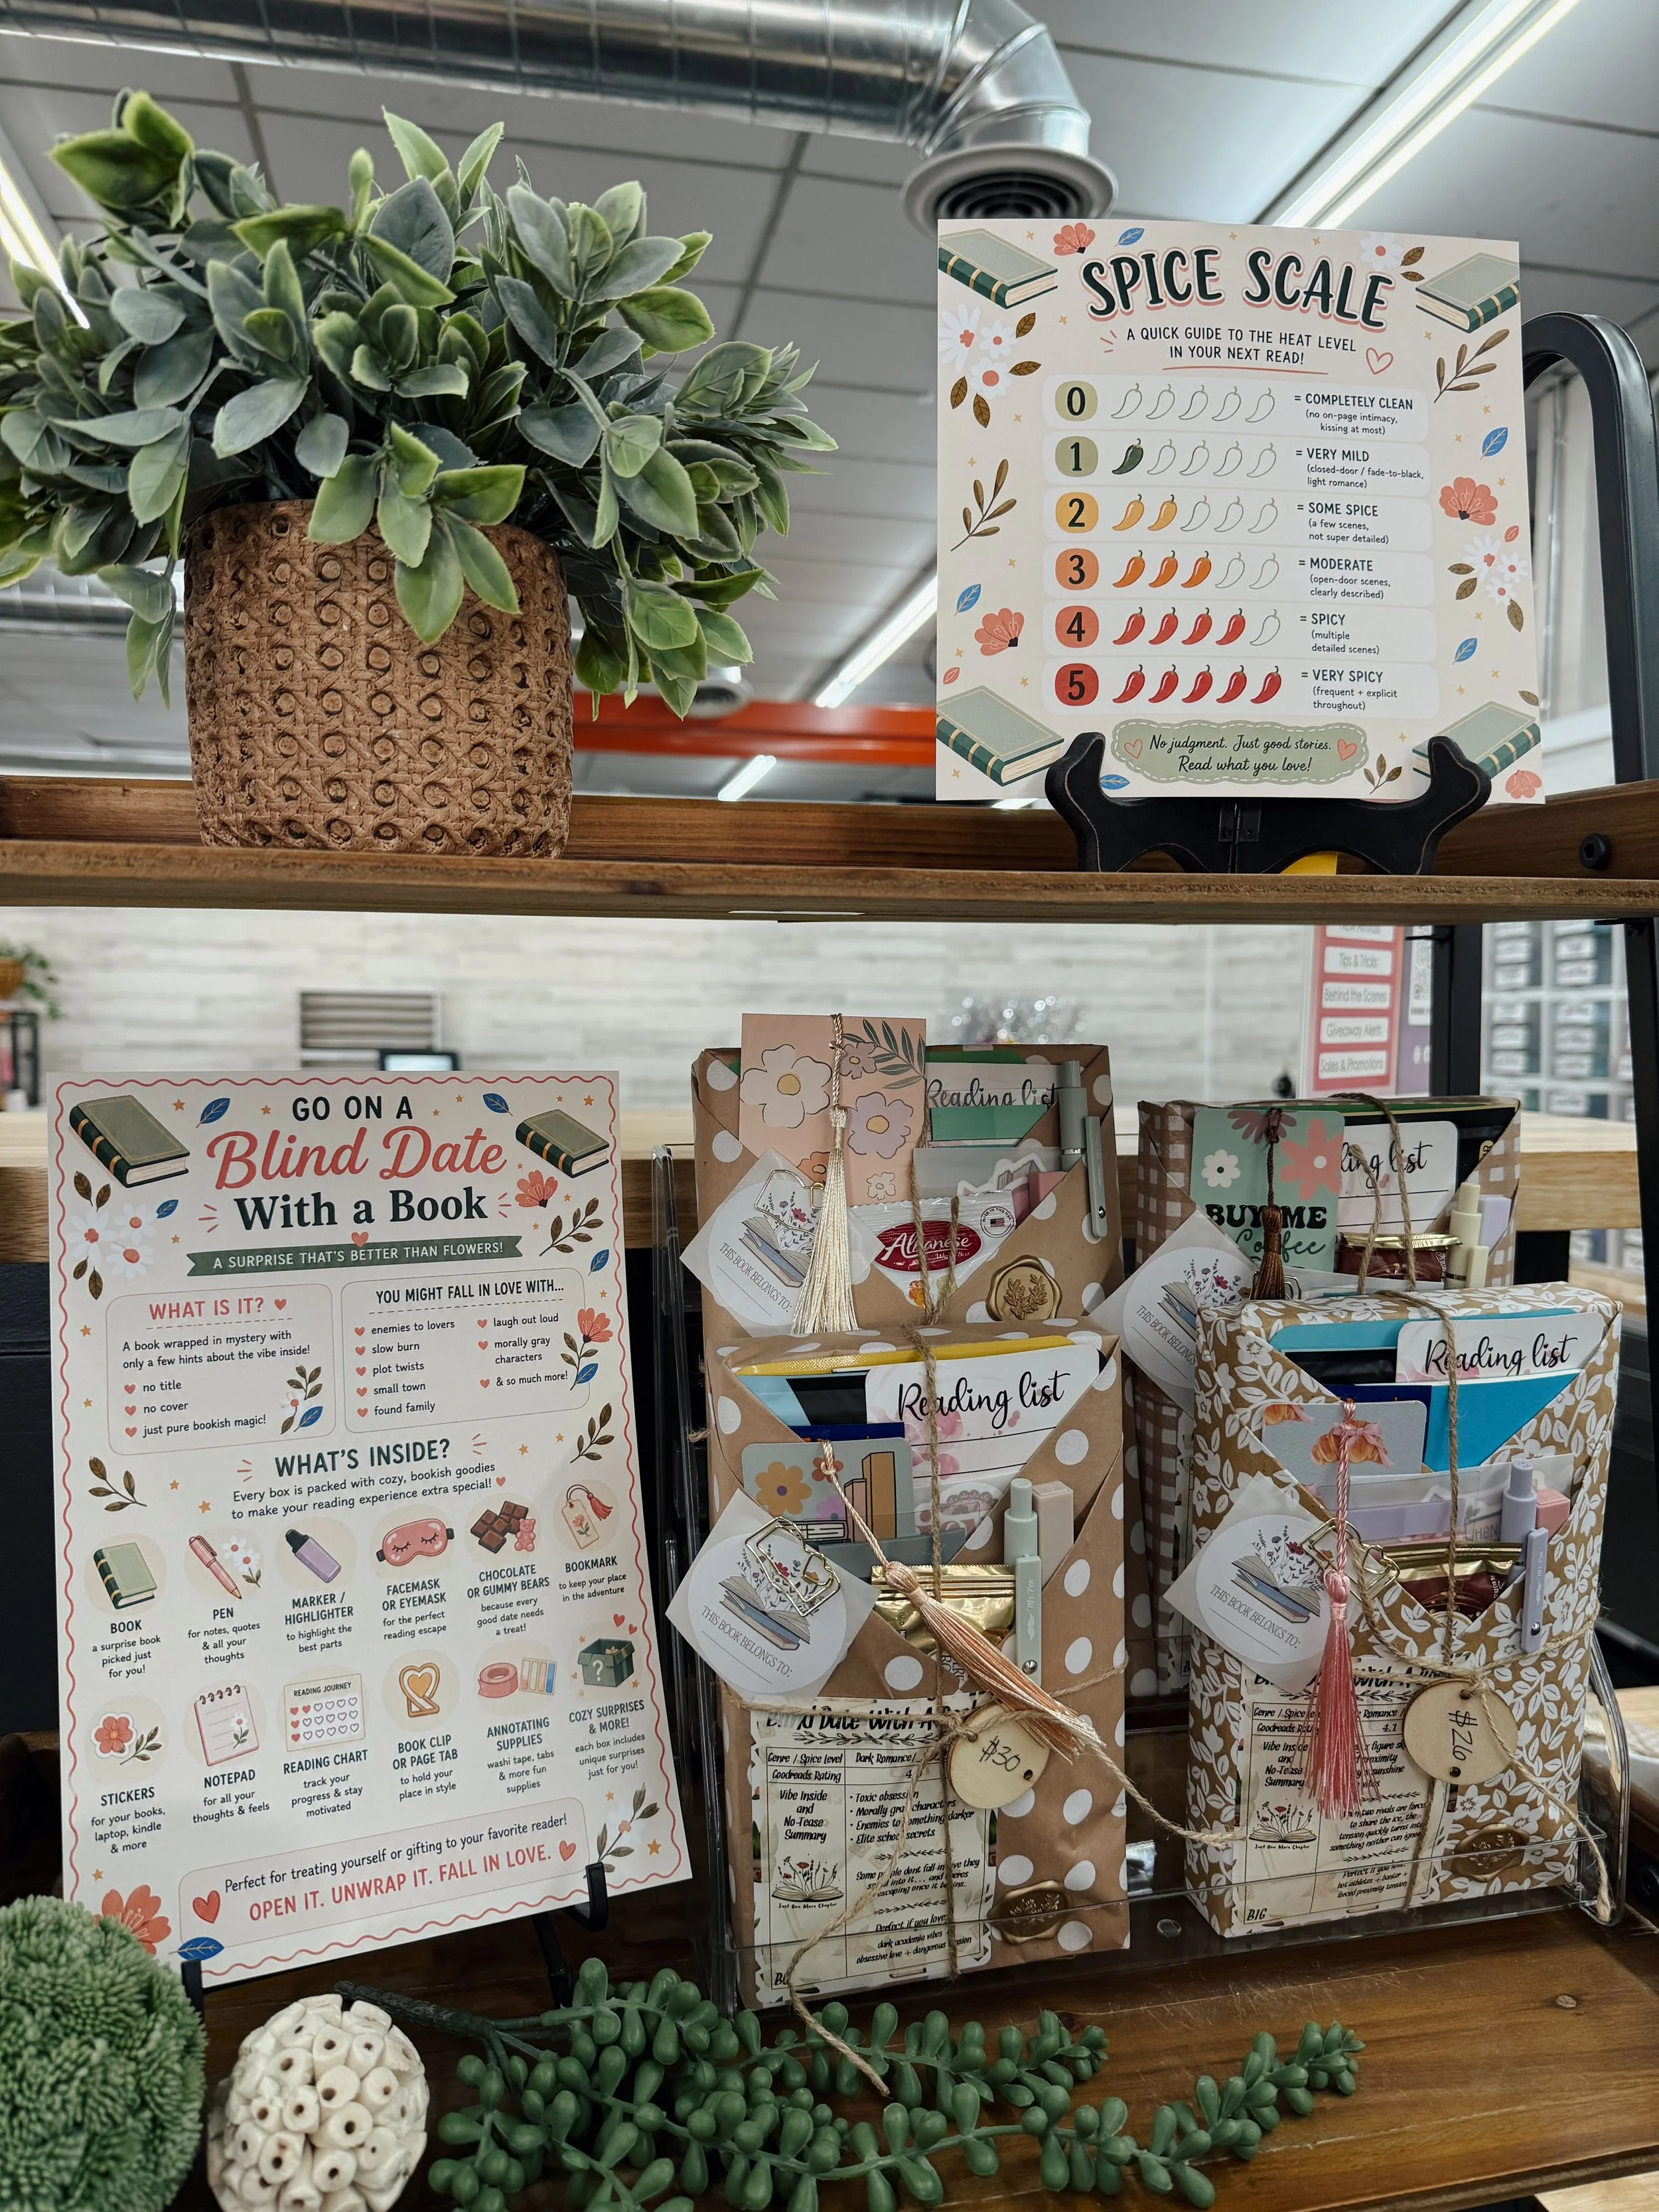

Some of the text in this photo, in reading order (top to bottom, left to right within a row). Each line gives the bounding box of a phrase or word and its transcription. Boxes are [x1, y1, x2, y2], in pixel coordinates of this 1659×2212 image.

[1081, 248, 1394, 330] SPICE SCALE
[1126, 327, 1356, 352] A QUICK GUIDE TO THE HEAT LEVEL
[1170, 345, 1304, 365] IN YOUR NEXT READ!
[1067, 386, 1086, 417] 0
[1306, 394, 1412, 409] COMPLETELY CLEAN
[1306, 409, 1398, 424] (no on-page intimacy,
[1321, 423, 1348, 434] kissing
[1362, 426, 1385, 435] most)
[1069, 442, 1082, 472] 1
[1307, 448, 1369, 461] VERY MILD
[1307, 464, 1358, 475] (closed-door
[1368, 468, 1423, 480] fade-to-black,
[1308, 477, 1367, 488] light romance)
[1068, 498, 1086, 528] 2
[1309, 502, 1378, 516] SOME SPICE
[1068, 555, 1086, 585] 3
[1311, 558, 1373, 571] MODERATE
[1066, 612, 1086, 642] 4
[1311, 613, 1345, 625] SPICY
[1068, 670, 1085, 701] 5
[1313, 670, 1383, 683] VERY SPICY
[1149, 735, 1331, 754] No judgment. Just good stories.
[1179, 755, 1312, 776] Read what you love!
[292, 1094, 413, 1123] GO ON A
[206, 1126, 508, 1191] Blind Date
[233, 1187, 488, 1232] With a Book
[1205, 1204, 1327, 1228] BUY ME
[213, 1258, 222, 1269] A
[228, 1252, 294, 1268] SURPRISE
[350, 1246, 399, 1261] BETTER
[404, 1244, 438, 1259] THAN
[443, 1242, 503, 1257] FLOWERS!
[881, 1233, 973, 1261] Alanese
[720, 1242, 792, 1311] THIS BOOK BELONGS TO:
[376, 1280, 564, 1304] YOU MIGHT FALL IN LOVE WITH...
[149, 1297, 264, 1320] WHAT IS IT?
[372, 1319, 455, 1335] enemies to lovers
[1136, 1305, 1154, 1323] THIS
[1150, 1319, 1172, 1340] BOOK
[1532, 1333, 1578, 1366] list
[143, 1380, 182, 1392] no title
[898, 1370, 1071, 1429] Reading list
[143, 1414, 266, 1438] just pure bookish magic!
[275, 1438, 450, 1477] WHAT'S INSIDE?
[479, 1564, 537, 1582] CHOCOLATE
[565, 1556, 618, 1573] BOOKMARK
[285, 1606, 354, 1625] HIGHLIGHTER
[1210, 1585, 1301, 1648] THIS BOOK BELONGS TO:
[110, 1619, 143, 1634] BOOK
[701, 1605, 792, 1677] THIS BOOK BELONGS TO:
[293, 1682, 352, 1697] READING JOURNEY
[1382, 1724, 1397, 1732] 4.1
[1447, 1711, 1478, 1762] $26
[768, 1753, 790, 1763] Genre
[800, 1753, 822, 1765] Spice
[825, 1753, 843, 1763] Level
[855, 1753, 874, 1765] Dark
[980, 1736, 1021, 1772] $30
[204, 1769, 255, 1788] NOTEPAD
[772, 1769, 841, 1783] Goodreads Rating
[101, 1787, 155, 1806] STICKERS
[779, 1789, 828, 1801] Vibe Inside
[796, 1803, 814, 1814] and
[784, 1816, 824, 1827] No-Tease
[784, 1829, 827, 1844] Summary
[250, 1844, 551, 1921] OPEN IT. UNWRAP IT. FALL IN LOVE.
[1247, 1908, 1267, 1921] BIG
